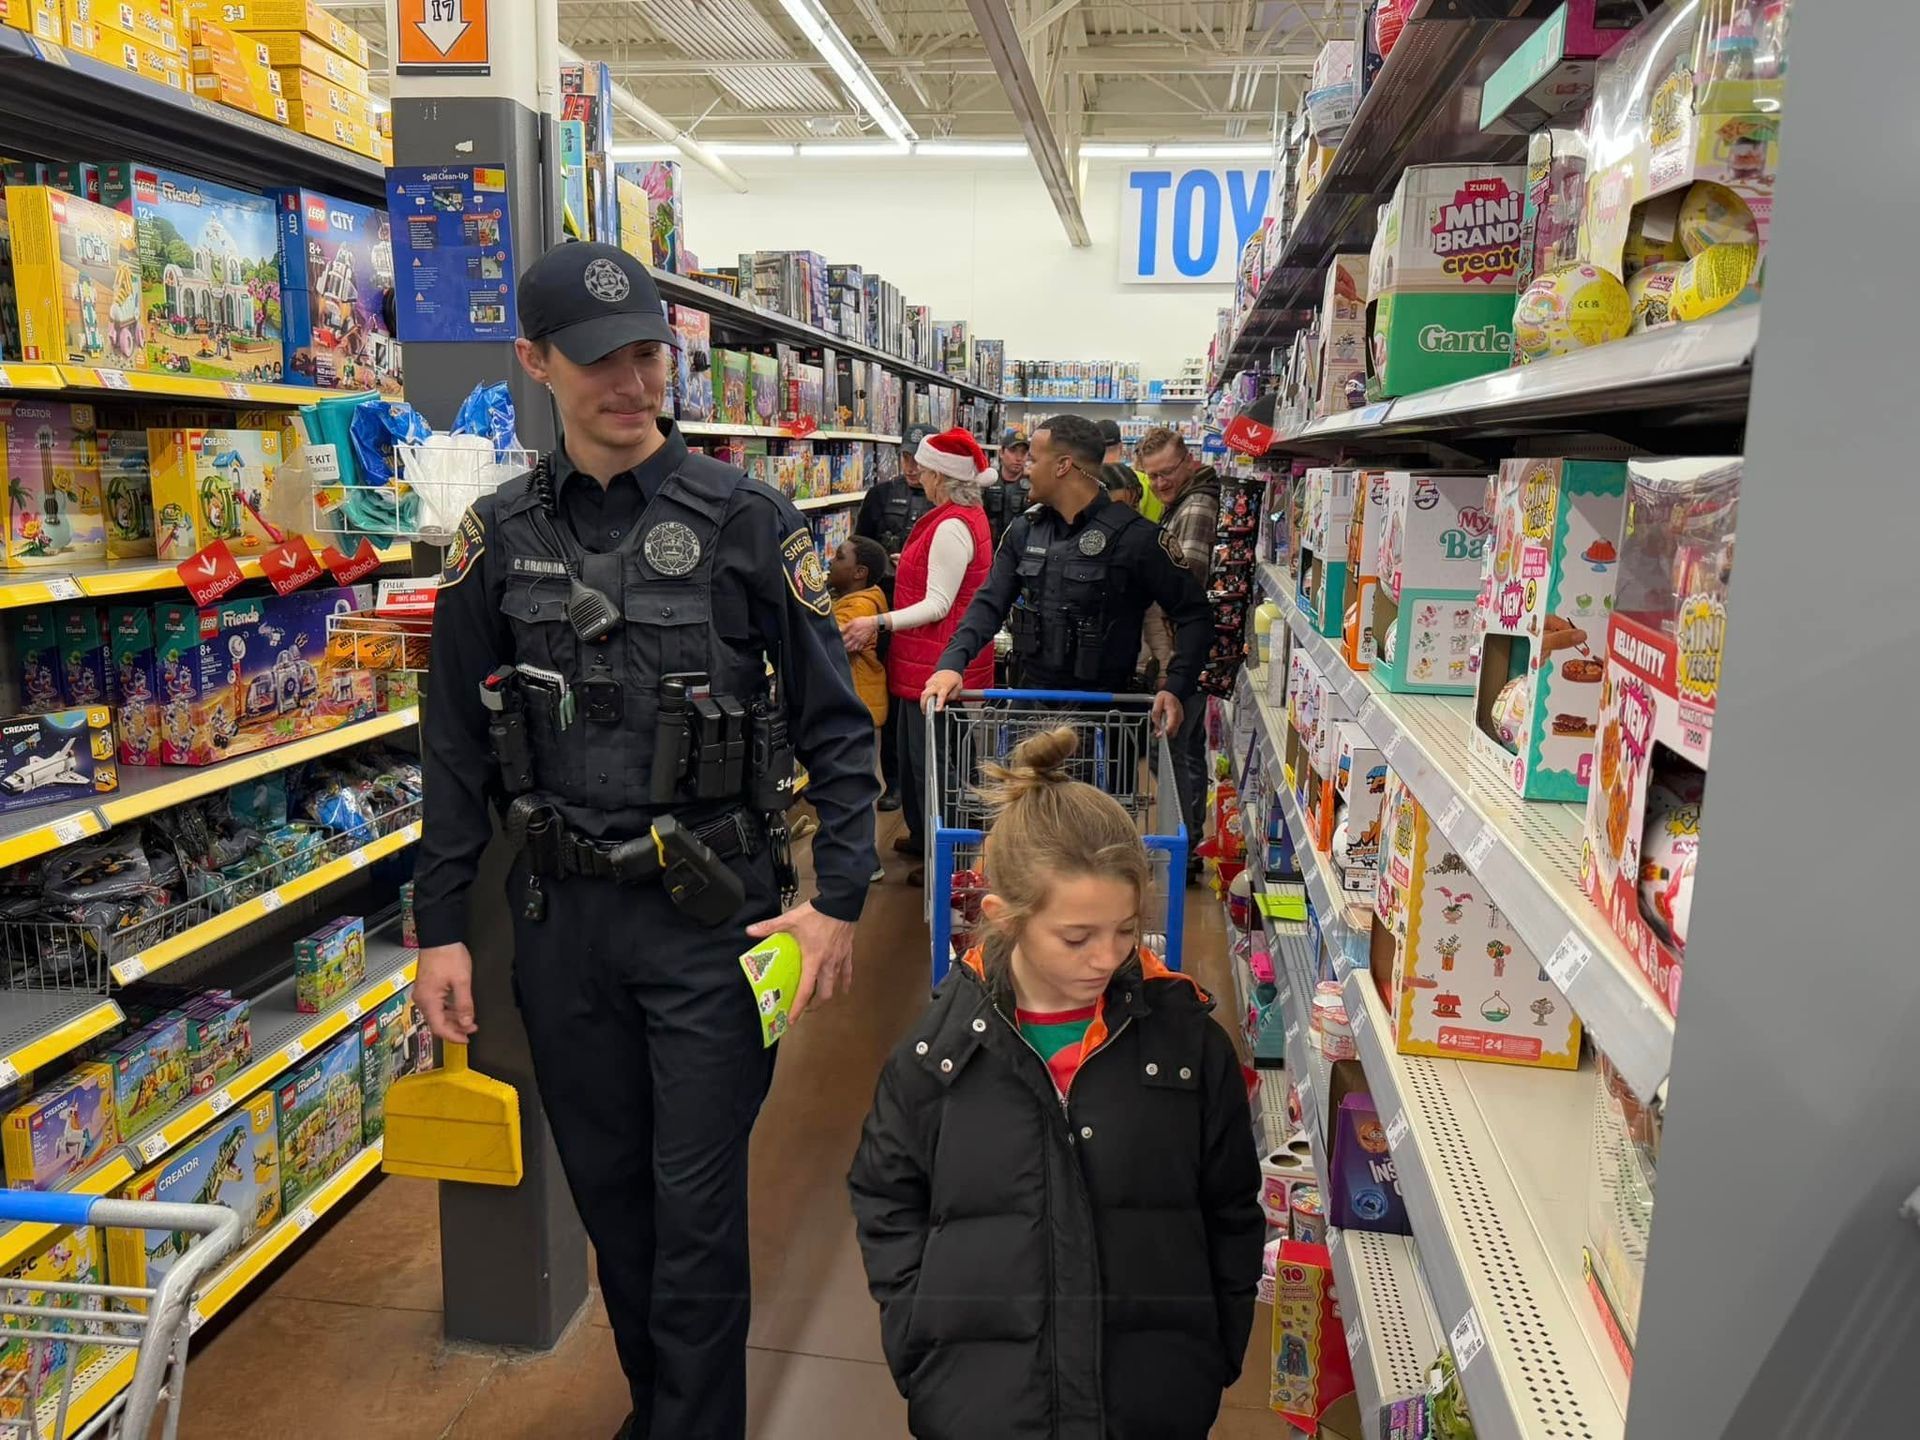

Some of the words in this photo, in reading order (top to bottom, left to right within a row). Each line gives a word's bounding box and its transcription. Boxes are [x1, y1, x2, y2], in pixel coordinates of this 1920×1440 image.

[432, 0, 454, 21] 17
[422, 172, 438, 182] Spill
[438, 171, 469, 181] Clean-Up
[1469, 183, 1497, 192] ZURU
[162, 183, 202, 208] Friends
[137, 206, 154, 220] 12+
[288, 213, 298, 235] CITY
[308, 206, 325, 221] LEGO
[330, 211, 354, 232] CITY
[1130, 168, 1274, 277] TOY
[309, 242, 321, 255] 8+
[1420, 324, 1512, 353] Garde
[15, 407, 51, 419] CREATOR
[203, 437, 232, 446] CREATOR
[1230, 434, 1261, 452] Rollback
[315, 454, 331, 465] KIT
[463, 513, 482, 545] ERIFF
[1460, 511, 1491, 533] My
[784, 534, 814, 562] SHER
[1440, 529, 1484, 561] Ba
[278, 565, 319, 592] Rollback
[338, 558, 377, 583] Rollback
[197, 571, 240, 602] Rollback
[1503, 592, 1520, 617] NEW
[201, 617, 218, 629] LEGO
[222, 604, 260, 627] Friends
[200, 644, 212, 656] 8+
[1614, 627, 1635, 664] HELLO
[1635, 642, 1666, 681] KITTY
[2, 722, 40, 735] CREATOR
[1624, 690, 1649, 746] NEW
[1440, 1033, 1458, 1046] 24
[1484, 1038, 1503, 1051] 24
[296, 1068, 322, 1094] Friends
[43, 1099, 69, 1120] CREATOR
[158, 1156, 200, 1192] CREATOR
[1368, 1160, 1398, 1184] INS
[1282, 1267, 1304, 1282] 10
